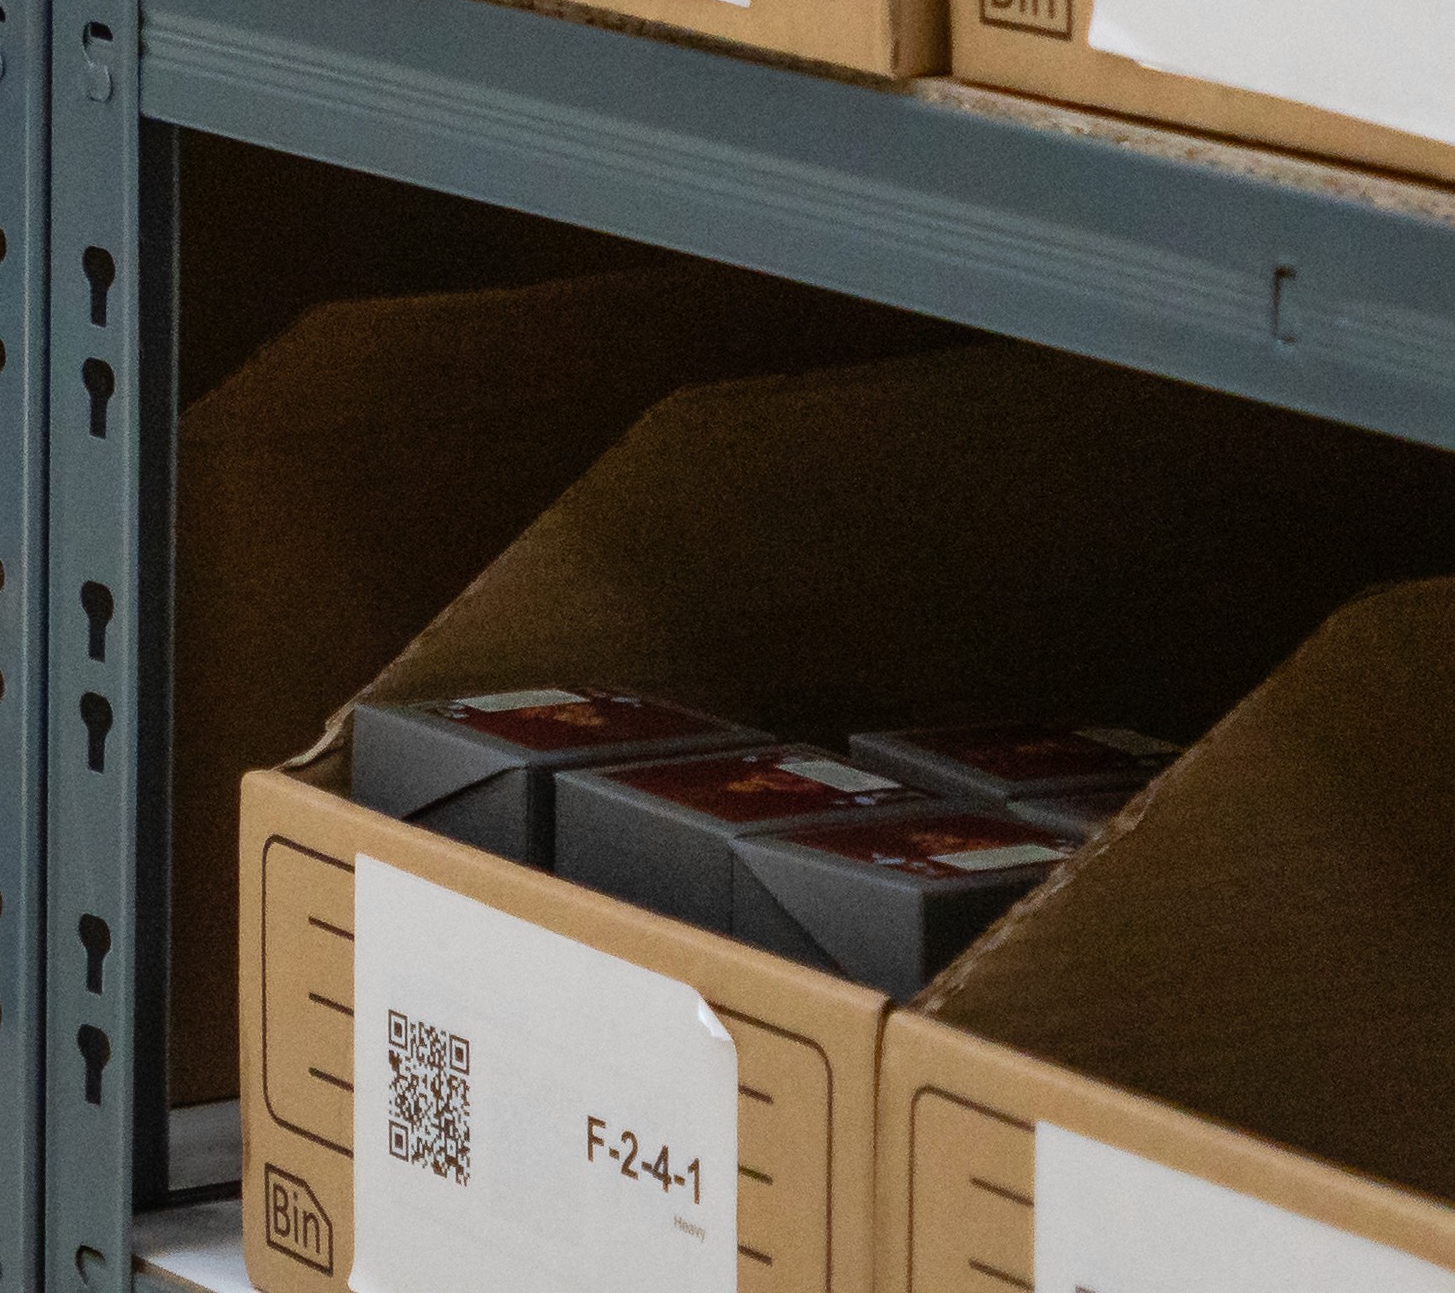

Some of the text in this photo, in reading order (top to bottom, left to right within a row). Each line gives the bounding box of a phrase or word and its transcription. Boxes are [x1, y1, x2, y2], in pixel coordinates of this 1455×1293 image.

[586, 1116, 703, 1206] F-2-4-1
[272, 1185, 322, 1253] Bin
[673, 1213, 707, 1243] Heavy
